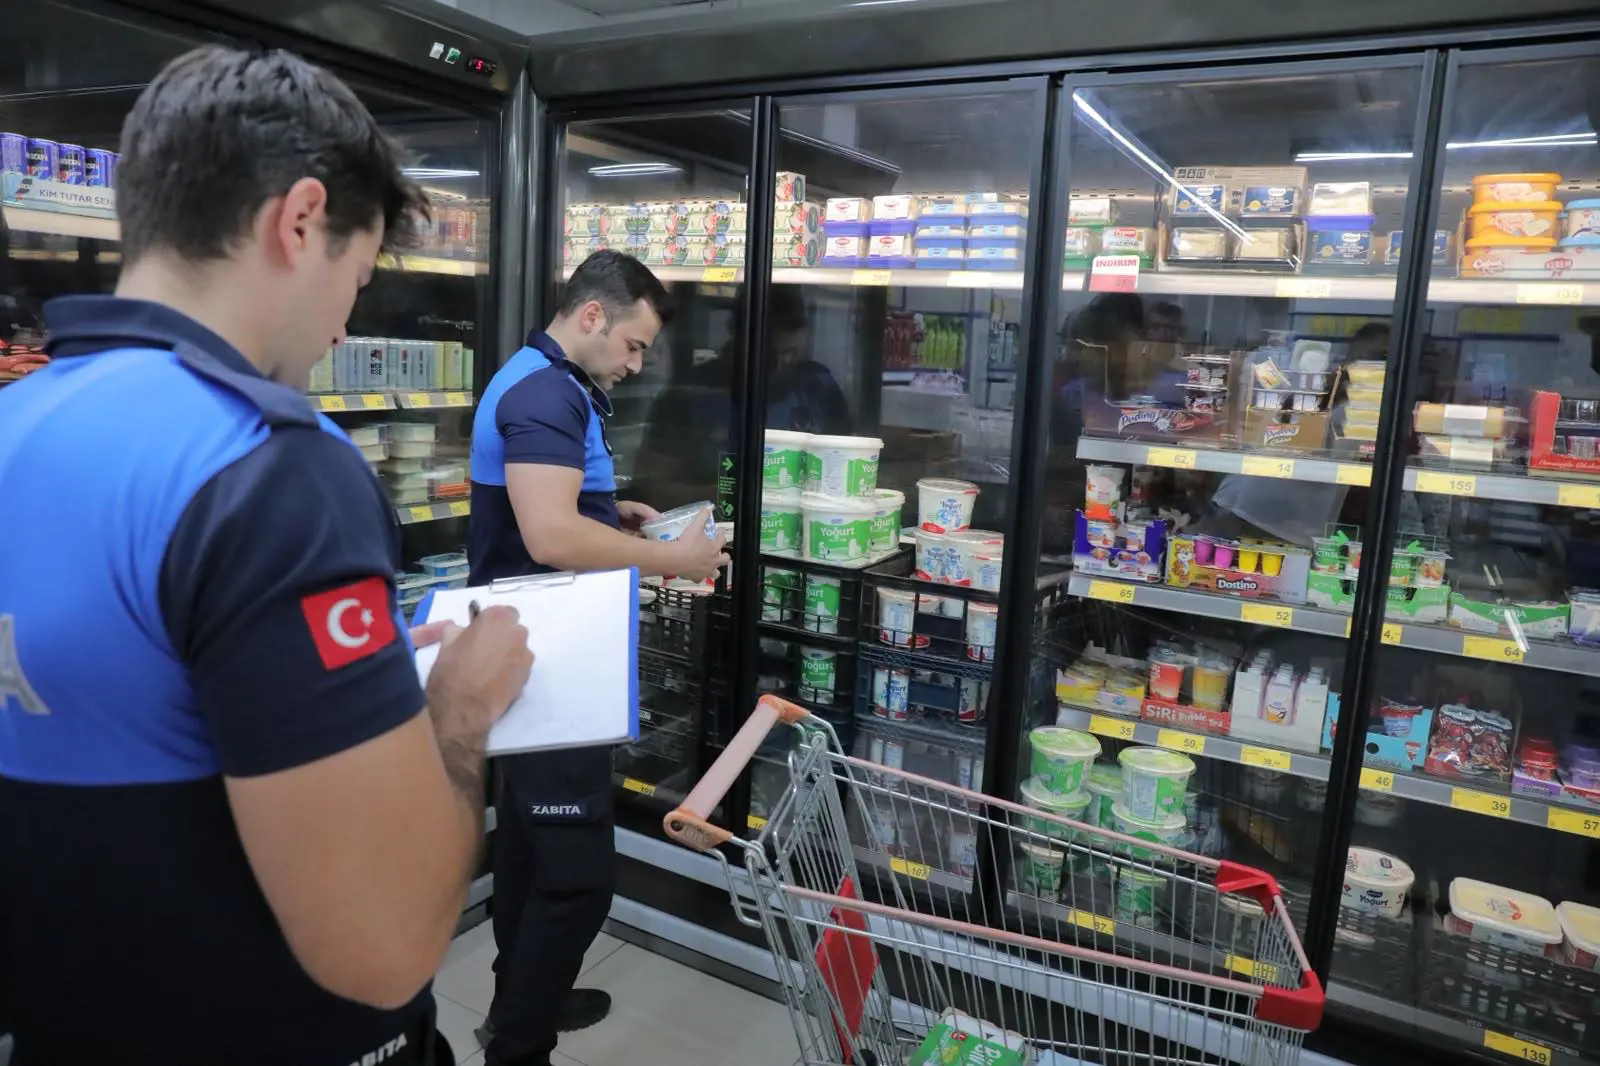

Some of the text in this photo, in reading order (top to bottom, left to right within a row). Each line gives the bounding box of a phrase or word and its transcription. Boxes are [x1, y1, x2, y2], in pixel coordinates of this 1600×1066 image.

[60, 192, 92, 203] TUTAR
[1449, 480, 1472, 492] 155
[820, 526, 855, 538] Yoğurt
[1217, 579, 1257, 590] Dostino
[1120, 588, 1132, 599] 65
[1275, 611, 1289, 621] 52
[1504, 646, 1521, 657] 64
[1120, 726, 1132, 736] 35
[1376, 776, 1389, 786] 46
[531, 804, 581, 815] ZABITA
[1491, 800, 1507, 812] 39
[1584, 819, 1600, 831] 57
[1521, 1047, 1547, 1064] 139
